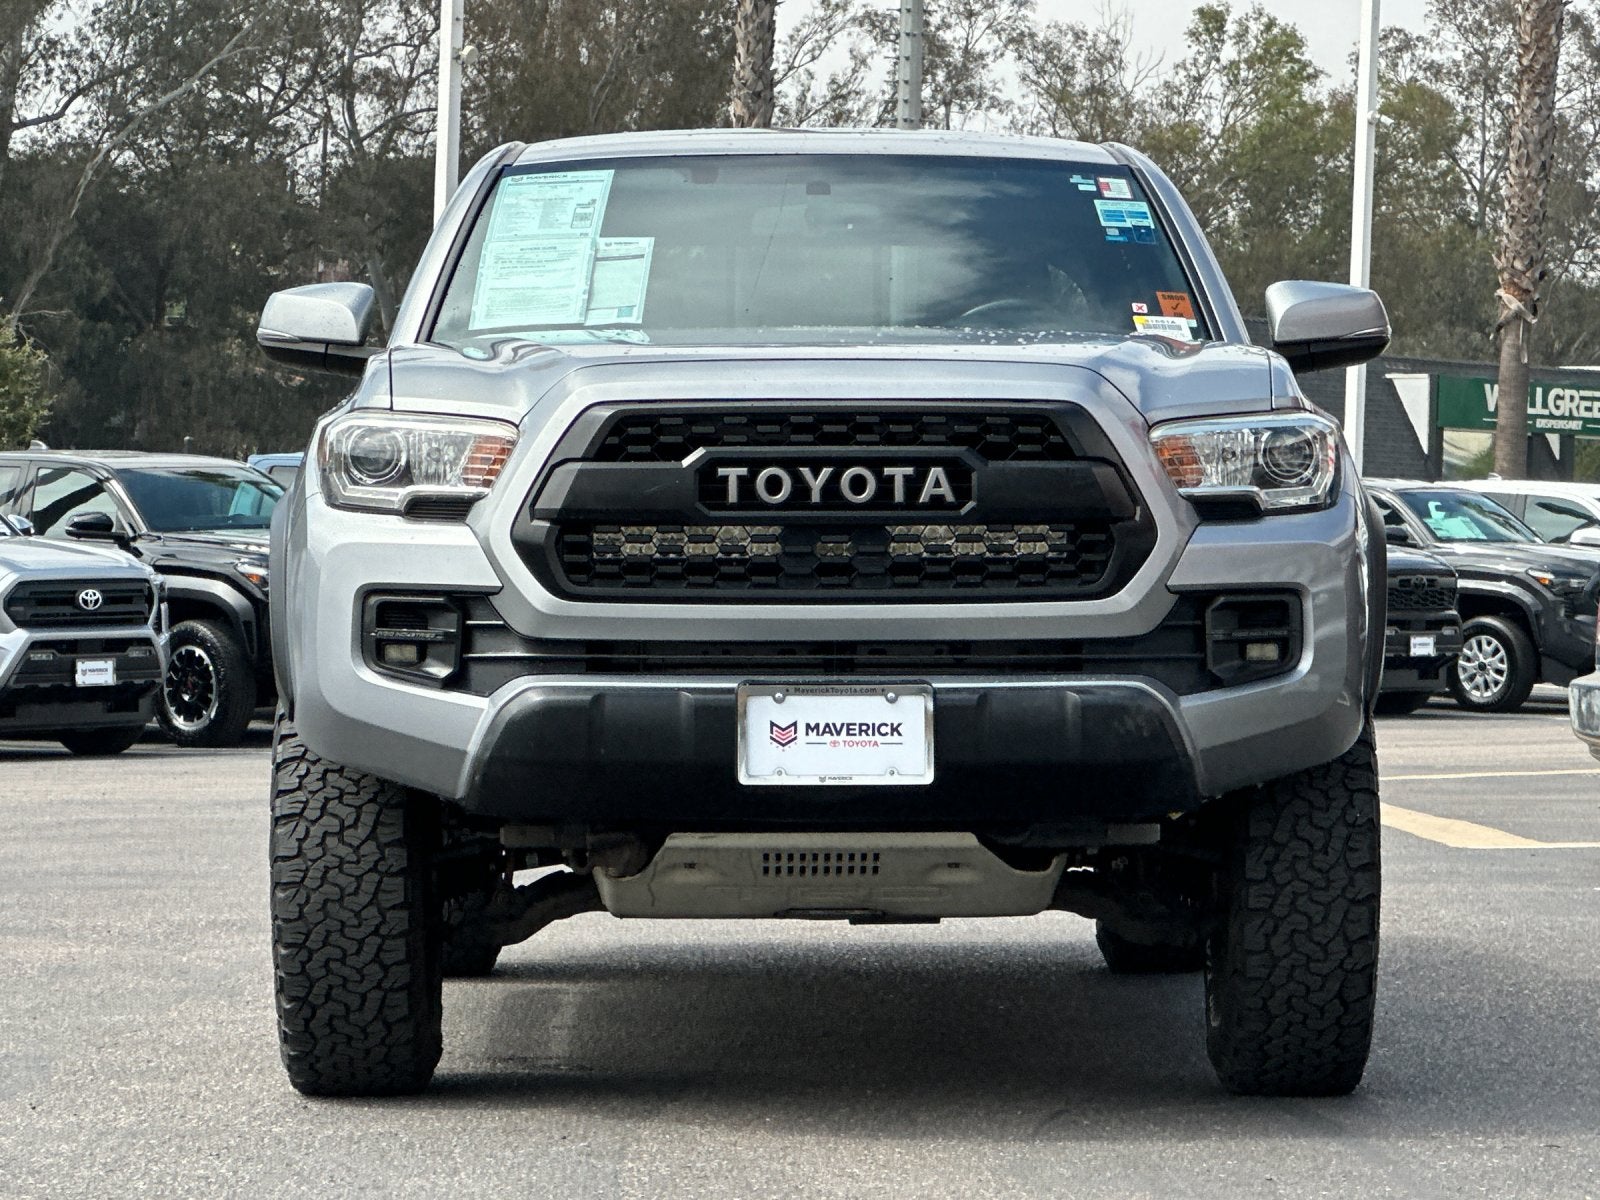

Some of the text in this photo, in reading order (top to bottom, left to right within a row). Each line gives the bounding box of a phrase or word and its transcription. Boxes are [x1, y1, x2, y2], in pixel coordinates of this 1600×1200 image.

[716, 466, 956, 504] TOYOTA
[793, 686, 878, 694] MaverickToyota.com
[805, 722, 903, 737] MAVERICK
[842, 740, 879, 748] TOYOTA
